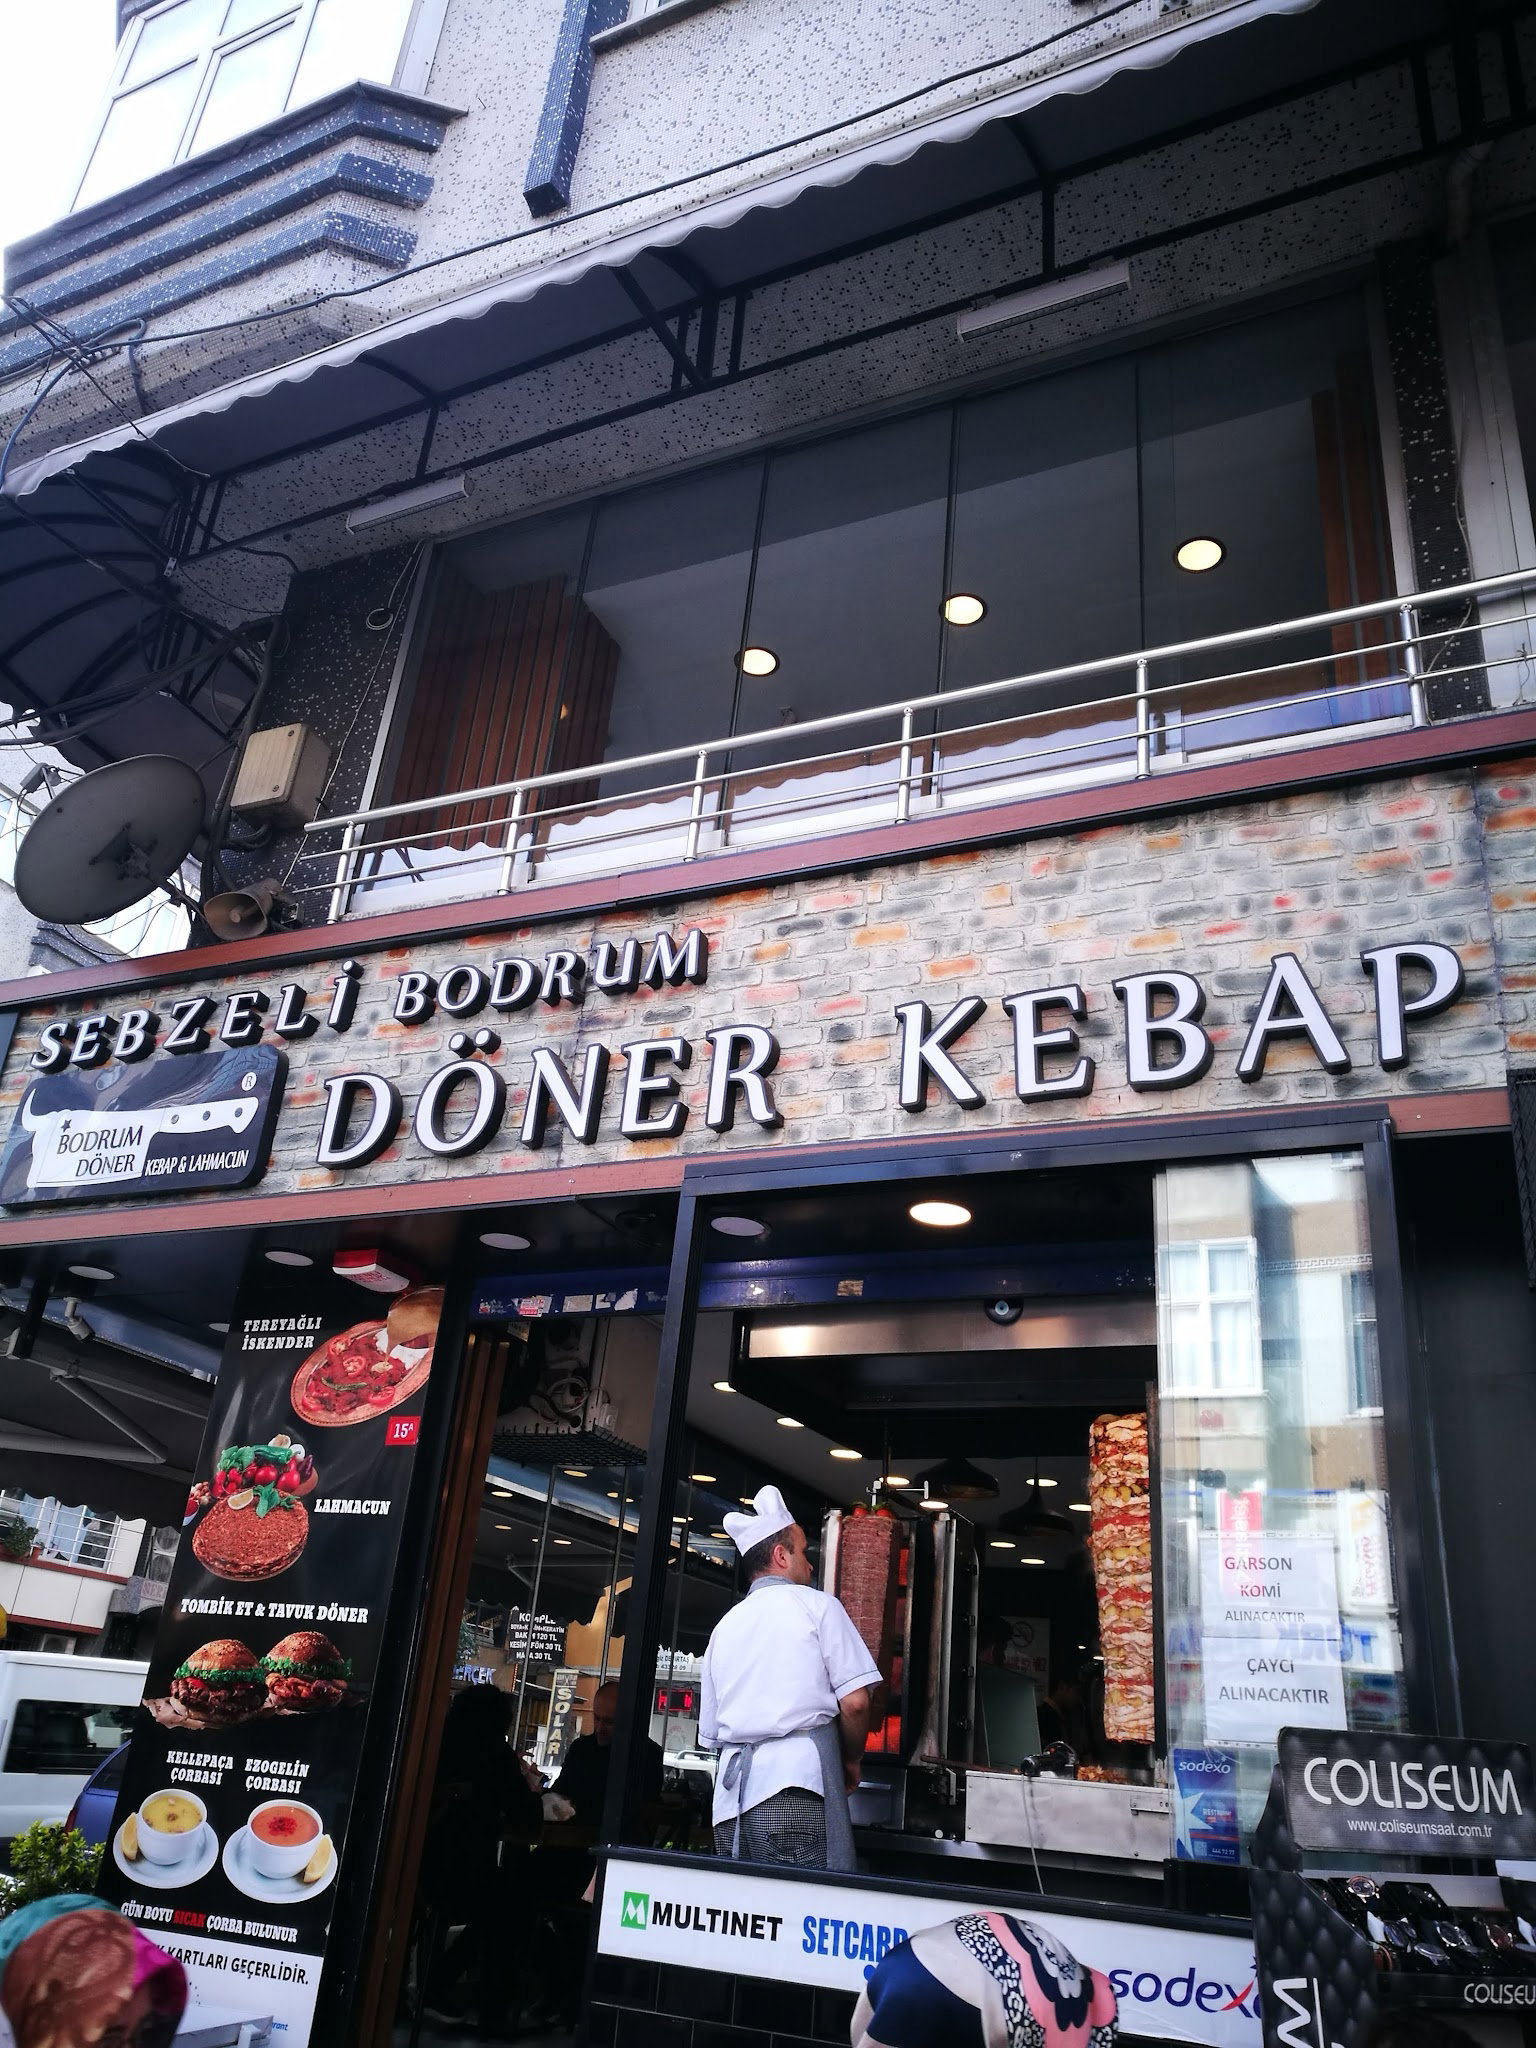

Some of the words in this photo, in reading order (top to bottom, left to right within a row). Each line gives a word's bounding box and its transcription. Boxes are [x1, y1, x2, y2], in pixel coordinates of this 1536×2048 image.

[31, 960, 362, 1072] SEBZELİ
[394, 928, 707, 1026] BODRUM
[316, 1025, 784, 1169] DÖNER
[895, 940, 1466, 1112] KEBAP
[57, 1124, 143, 1155] BODRUM
[75, 1153, 135, 1177] DÖNER
[145, 1158, 177, 1176] KEBAP
[178, 1156, 187, 1173] &
[188, 1150, 249, 1172] LAHMACUN
[243, 1315, 322, 1332] TEREYAĞLI
[241, 1335, 315, 1351] İSKENDER
[314, 1498, 391, 1516] LAHMACUN
[1224, 1557, 1292, 1571] GARSON
[1240, 1583, 1281, 1598] KOMİ
[180, 1596, 235, 1615] TOMBİK
[235, 1601, 254, 1616] ET
[255, 1602, 266, 1617] &
[268, 1602, 316, 1620] TAVUK
[316, 1602, 369, 1624] DÖNER
[1225, 1610, 1306, 1623] ALINACAKTIR
[555, 1644, 563, 1652] TL
[1219, 1686, 1329, 1704] ALINACAKTIR
[166, 1750, 234, 1771] KELLEPAÇA
[244, 1759, 310, 1778] EZOGELİN
[1178, 1760, 1231, 1774] sodexo
[170, 1767, 223, 1785] ÇORBASI
[245, 1775, 302, 1794] ÇORBASI
[1303, 1757, 1523, 1815] COLISEUM
[1348, 1819, 1492, 1838] www.coliseumsaat.com.tr
[120, 1900, 143, 1919] GÜN
[143, 1904, 173, 1922] BOYU
[173, 1910, 207, 1928] SICAK
[206, 1914, 243, 1934] ÇORBA
[243, 1921, 298, 1943] BULUNUR
[652, 1901, 783, 1942] MULTINET
[167, 1945, 229, 1971] KARTLARI
[1108, 1966, 1262, 2019] sodex
